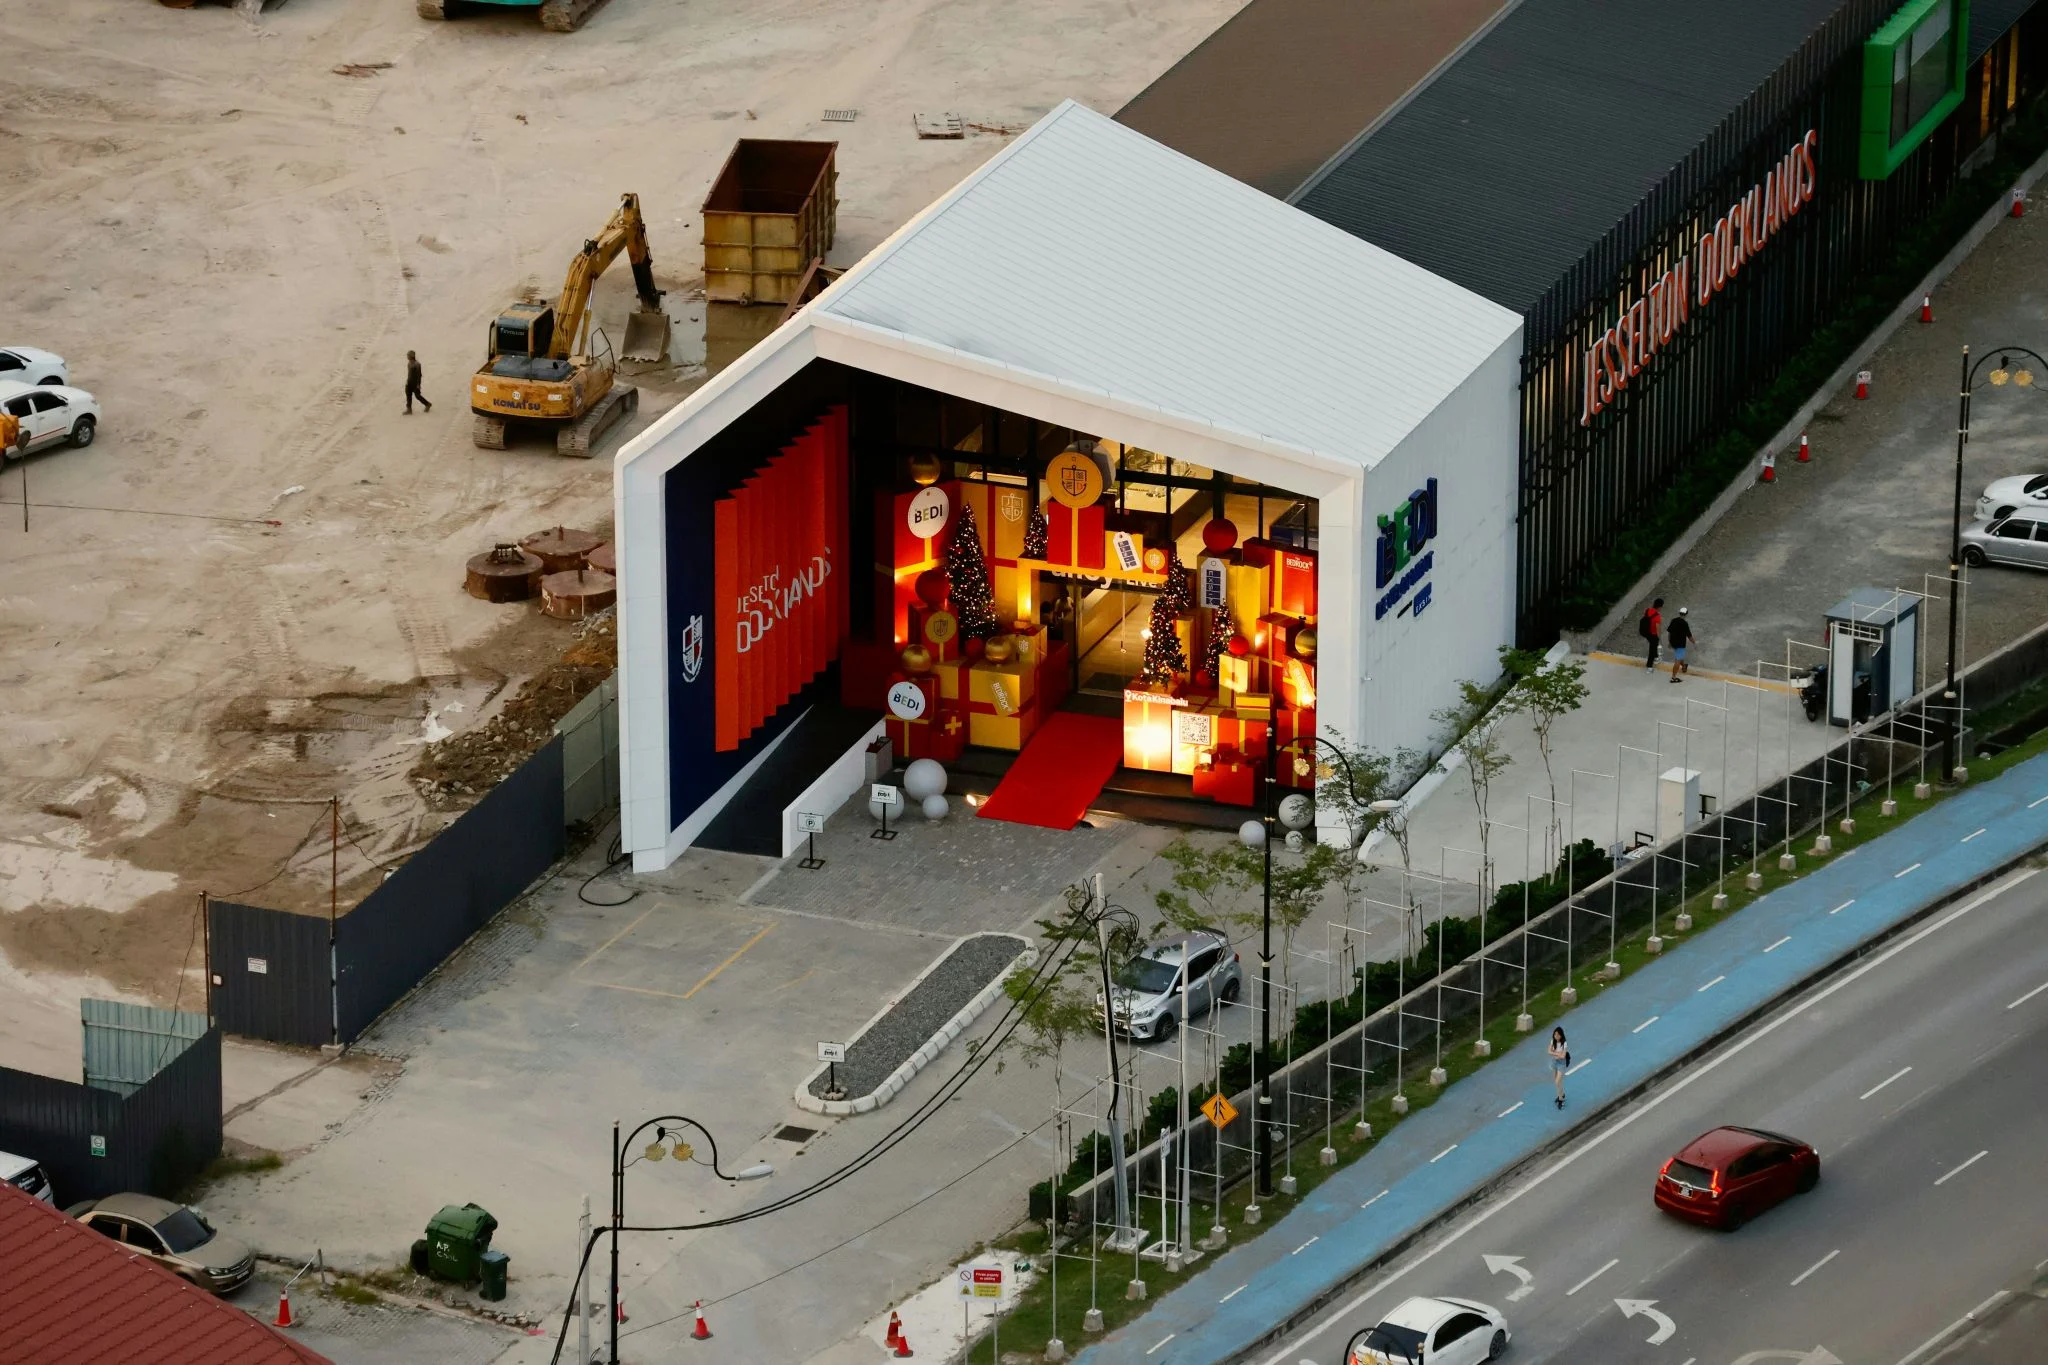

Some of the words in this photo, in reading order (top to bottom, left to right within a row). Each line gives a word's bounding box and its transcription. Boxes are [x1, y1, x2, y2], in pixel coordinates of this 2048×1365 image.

[1580, 255, 1689, 427] JESSELTON
[1698, 129, 1817, 307] DOCKLANDS
[493, 398, 541, 411] KOMATSU
[914, 504, 943, 523] BEDI
[1375, 477, 1438, 589] BEDI
[893, 691, 920, 711] BEDI
